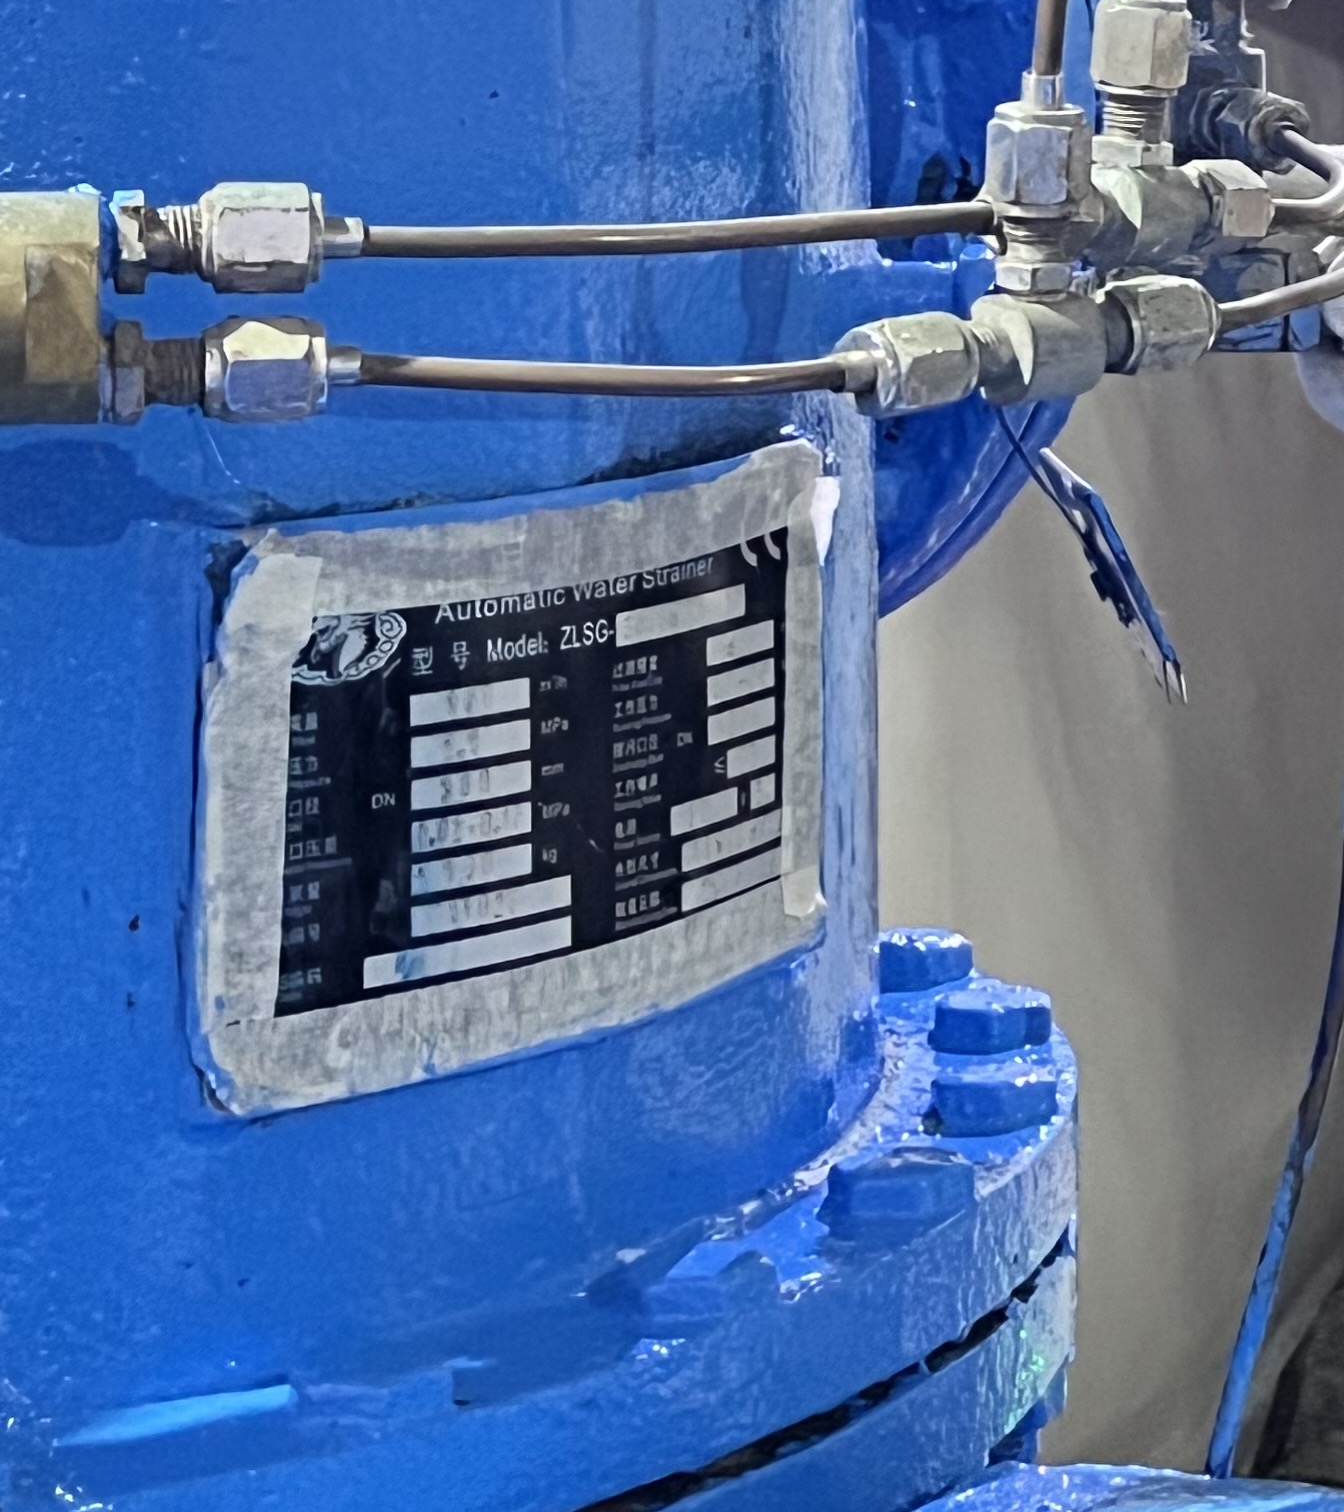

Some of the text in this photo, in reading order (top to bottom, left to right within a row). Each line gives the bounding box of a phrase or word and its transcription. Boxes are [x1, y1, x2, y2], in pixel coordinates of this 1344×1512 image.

[435, 556, 714, 625] Automatic Water Strainer
[487, 631, 549, 663] Model:
[371, 793, 396, 810] DN
